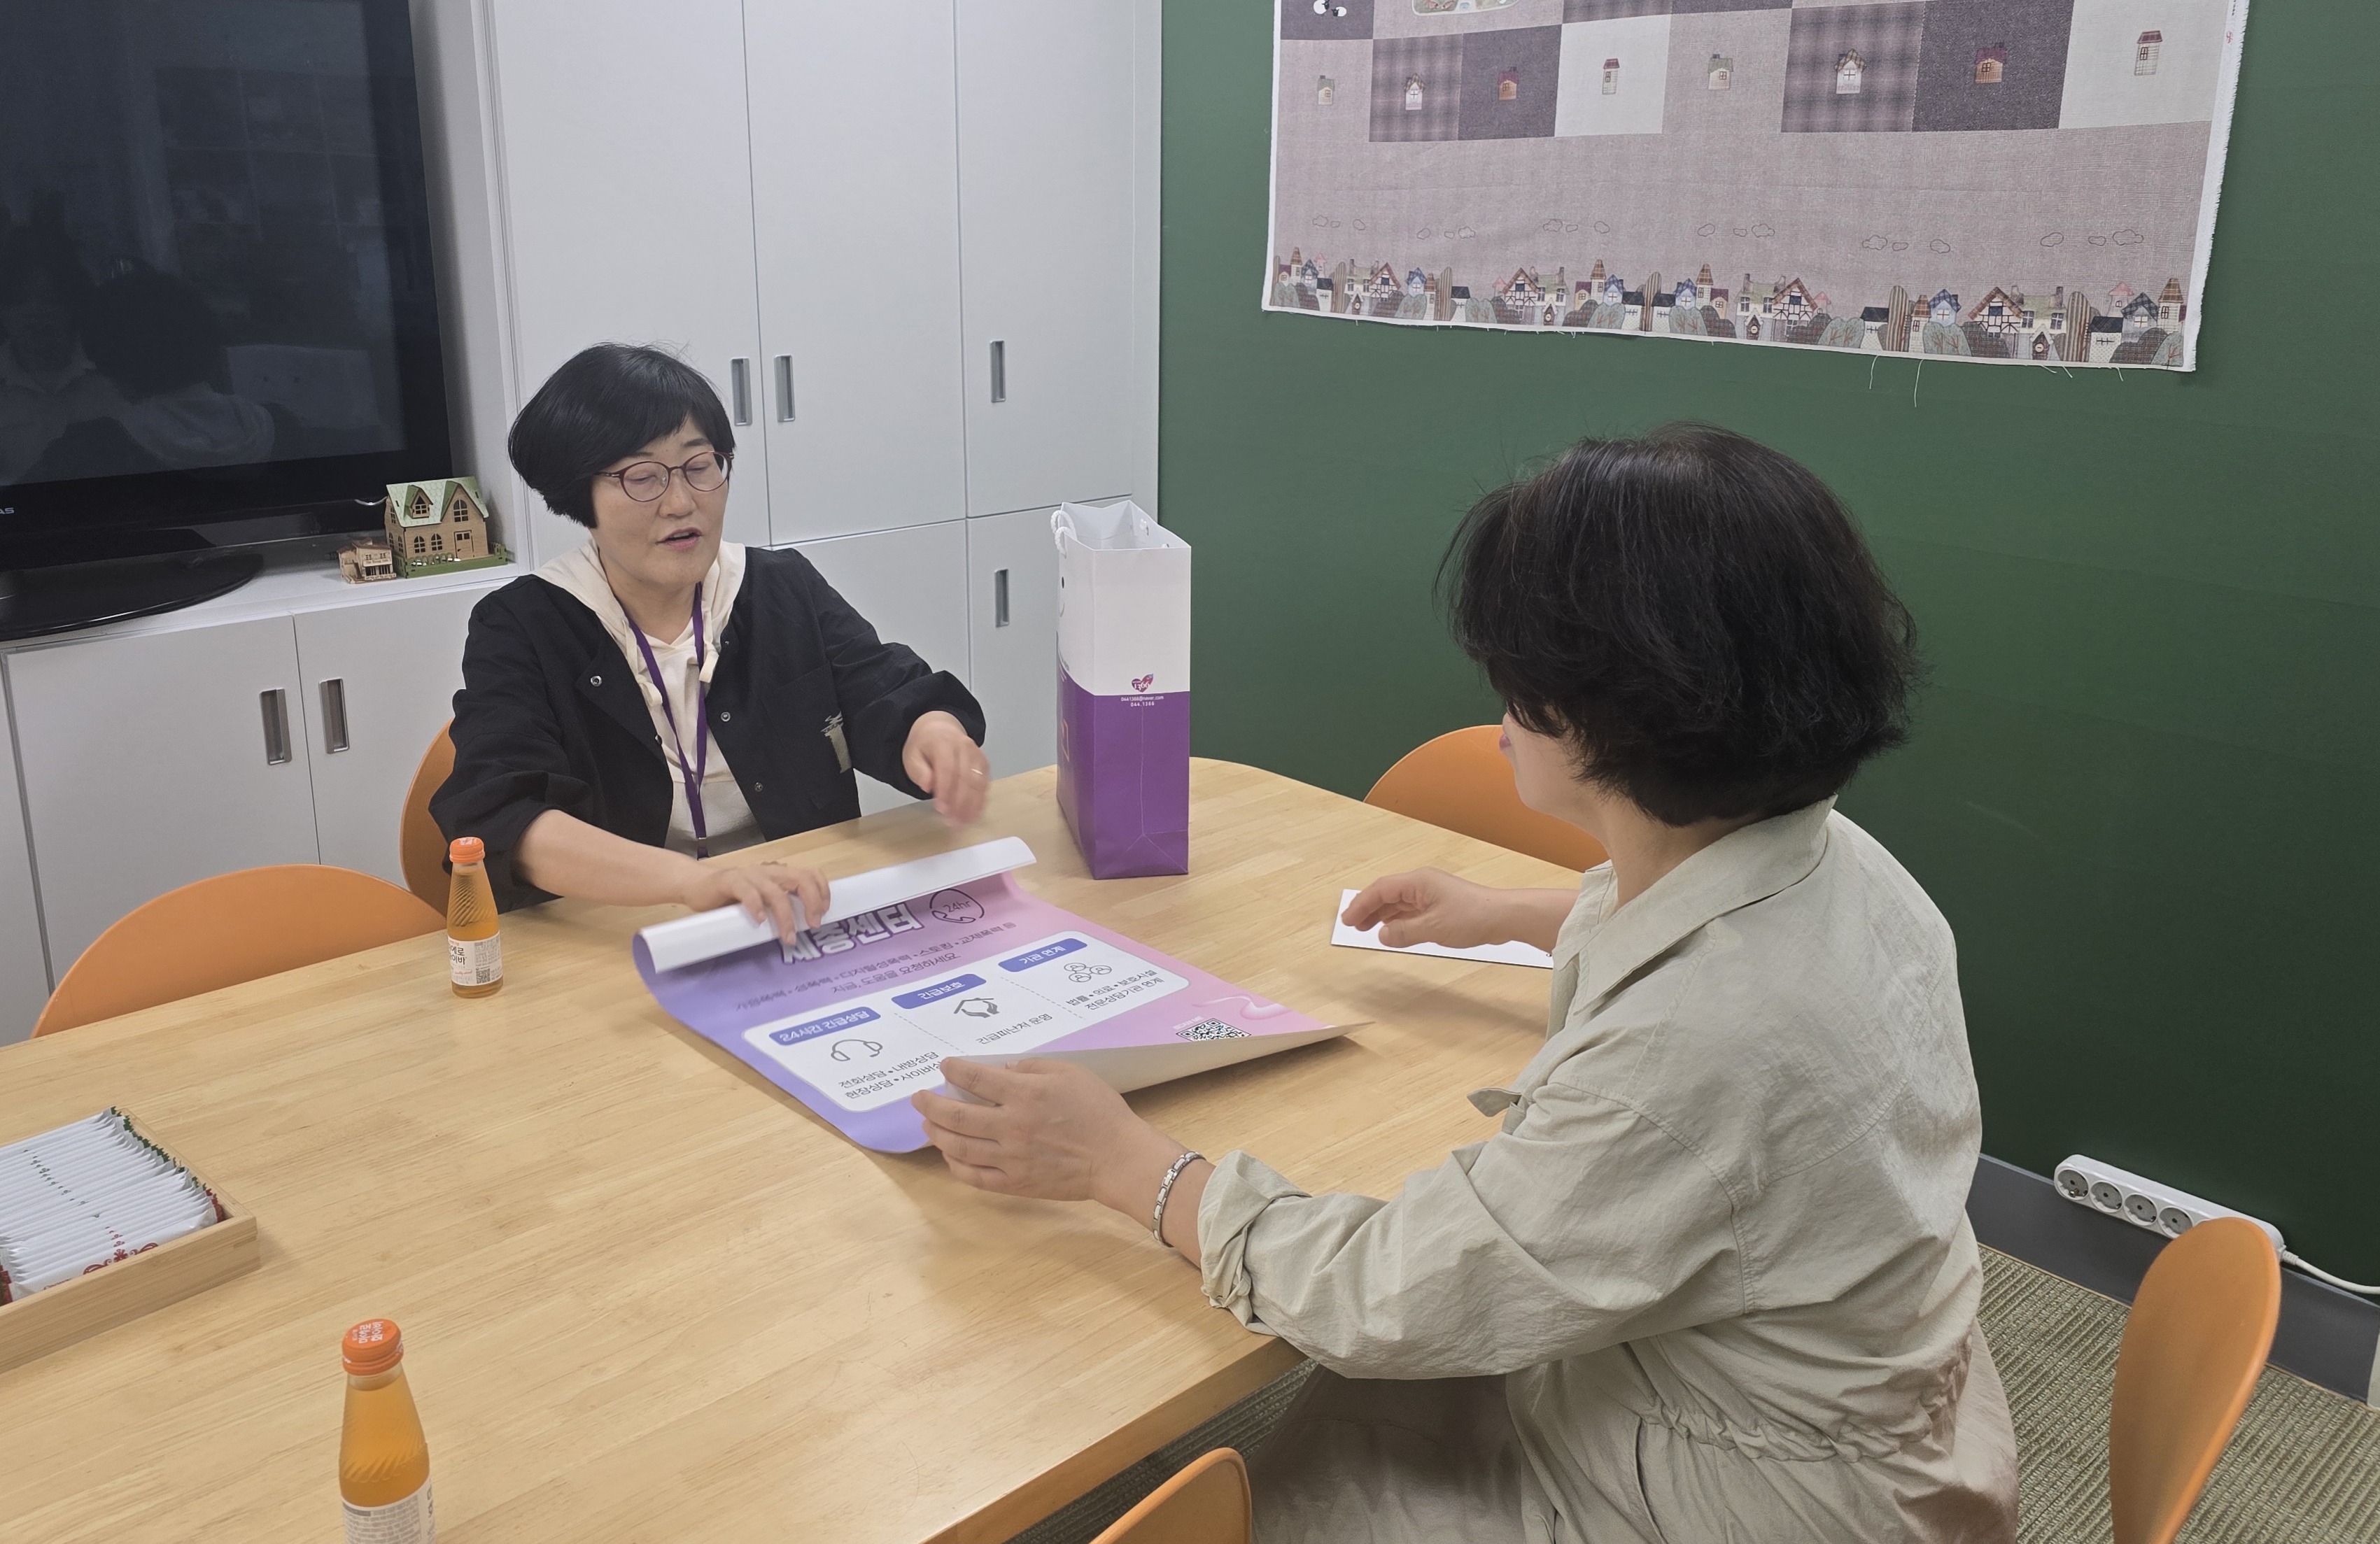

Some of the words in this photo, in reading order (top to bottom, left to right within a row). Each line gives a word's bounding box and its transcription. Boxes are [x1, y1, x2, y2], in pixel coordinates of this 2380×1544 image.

[943, 900, 971, 913] 24hr
[919, 942, 954, 956] 스토킹
[1018, 954, 1043, 965] 기관
[1041, 945, 1066, 956] 연계
[861, 970, 899, 985] 도움을
[899, 952, 962, 975] 요청하세요
[917, 981, 966, 1000] 긴급보호
[1066, 995, 1090, 1006] 법률
[1093, 985, 1115, 996] 의료
[1117, 970, 1158, 986] 보호시설
[1085, 987, 1144, 1010] 전문상담기관
[1141, 977, 1164, 988] 연계
[779, 1024, 822, 1042] 24시간
[824, 1010, 871, 1029] 긴급상담
[976, 1021, 1031, 1044] 긴급피난처
[1029, 1013, 1053, 1026] 운영
[838, 1070, 887, 1089] 전화상담
[892, 1051, 940, 1072] 내방상담
[845, 1079, 894, 1099] 현장상담
